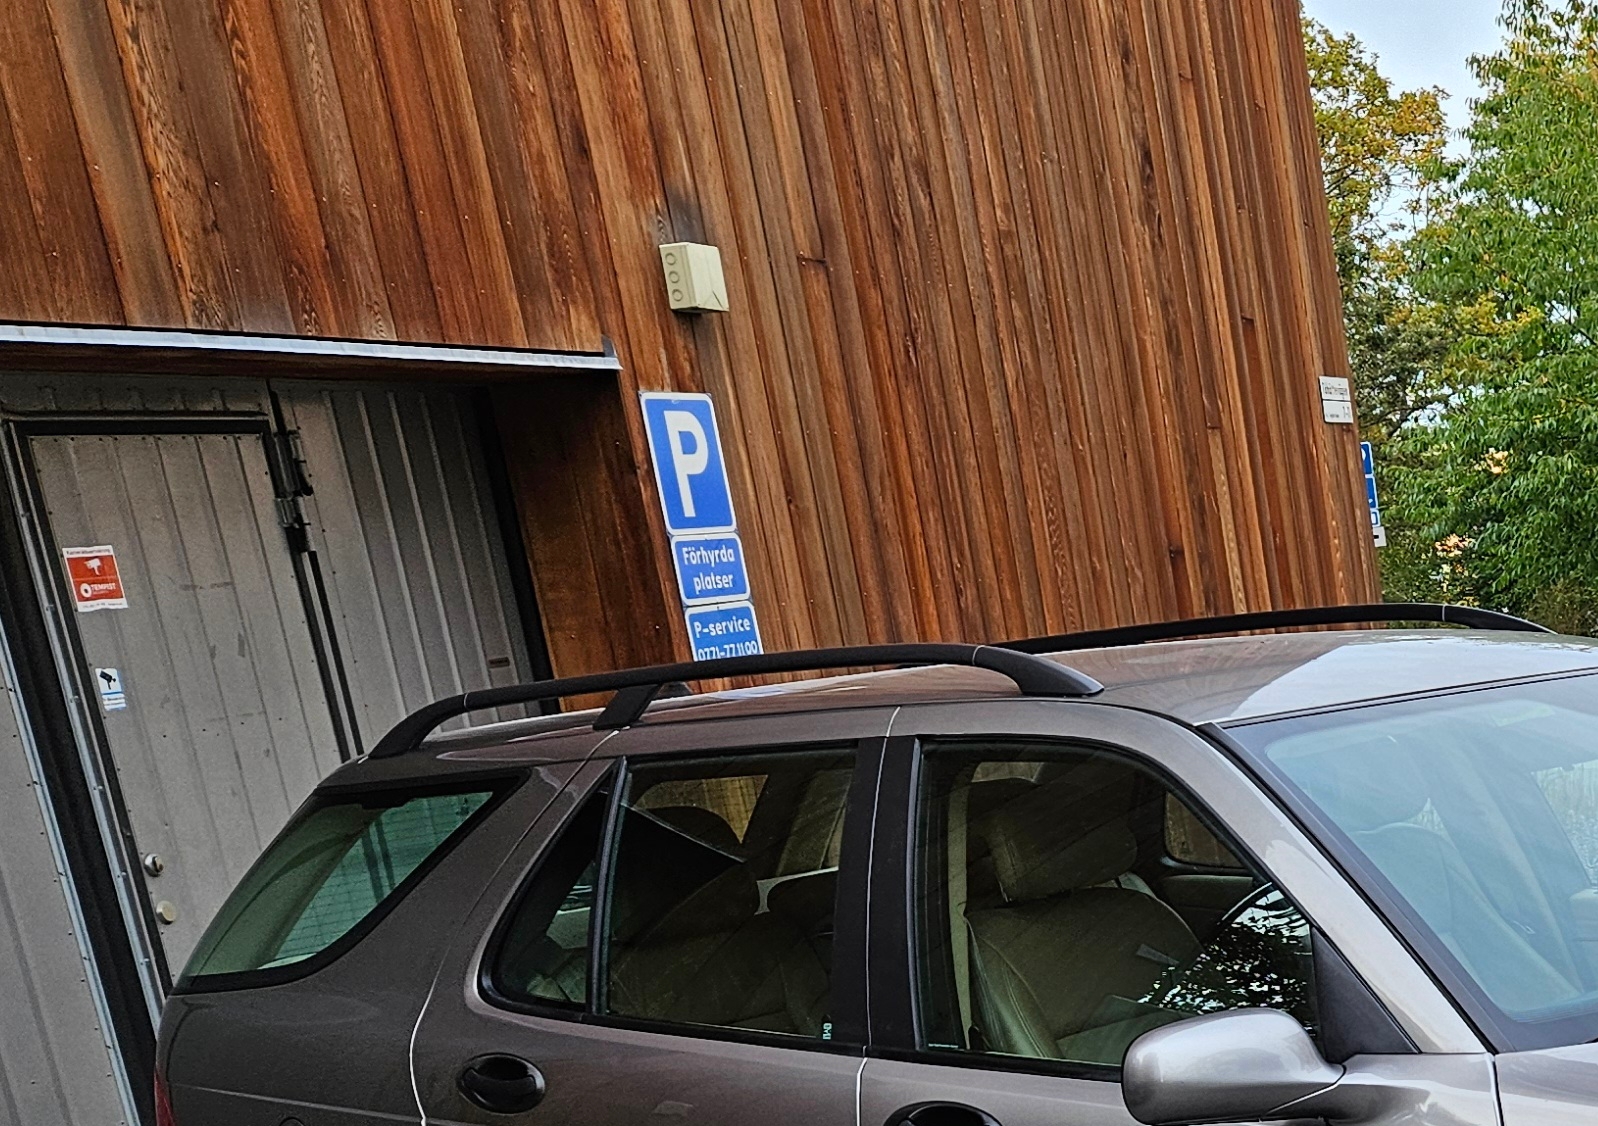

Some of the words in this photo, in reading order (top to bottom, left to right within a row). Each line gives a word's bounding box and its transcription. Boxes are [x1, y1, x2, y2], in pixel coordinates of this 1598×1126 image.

[663, 410, 709, 518] P
[682, 544, 735, 567] Förhyrda
[693, 571, 734, 594] platser
[693, 615, 751, 638] P-service
